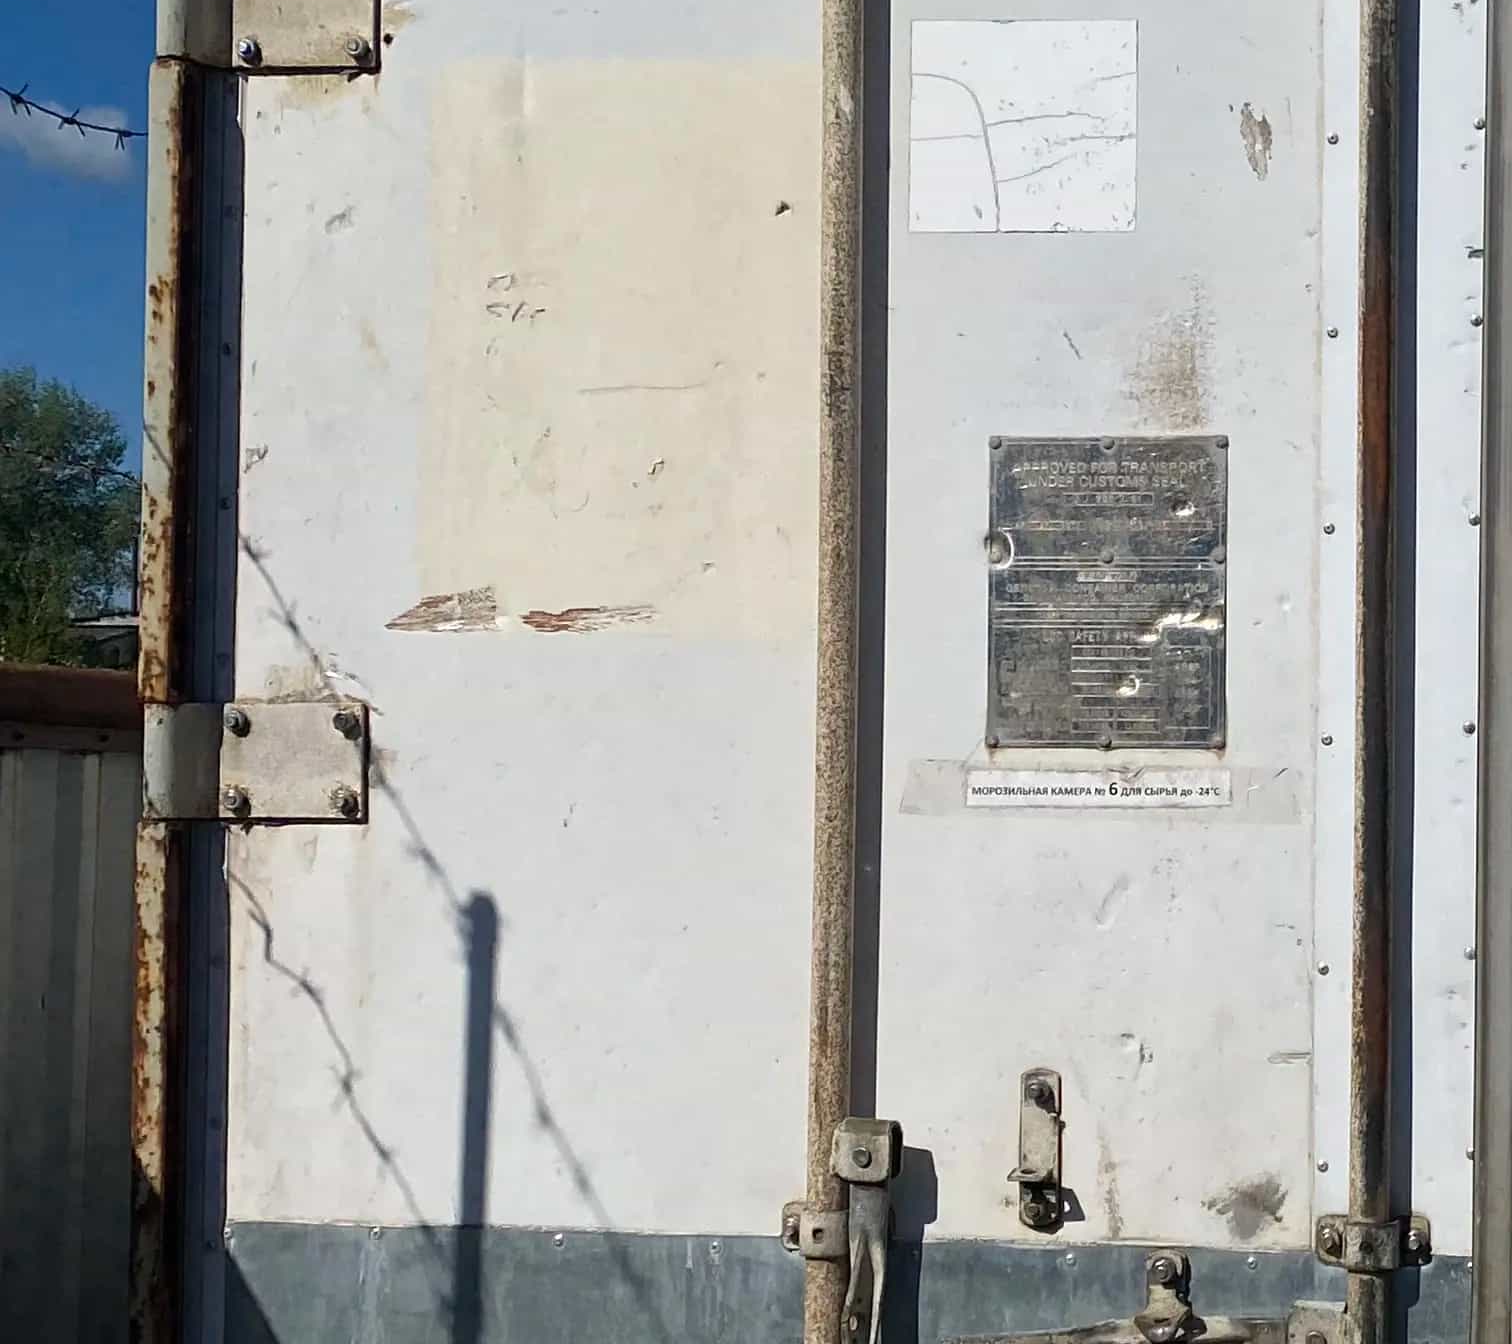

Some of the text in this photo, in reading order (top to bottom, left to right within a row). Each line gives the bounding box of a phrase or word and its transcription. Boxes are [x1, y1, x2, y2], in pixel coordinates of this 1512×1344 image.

[1012, 461, 1205, 475] APPROVED FOR TRANSPORT
[1026, 475, 1186, 489] UNDER CUSTOMS SEAL
[971, 786, 1048, 796] МОРОЗИЛЬНАЯ
[1051, 786, 1092, 796] КАМЕРА
[1094, 787, 1106, 796] №
[1109, 782, 1118, 796] 6
[1120, 787, 1142, 797] ДЛЯ
[1144, 787, 1178, 796] СЫРЬЯ
[1180, 788, 1193, 797] до
